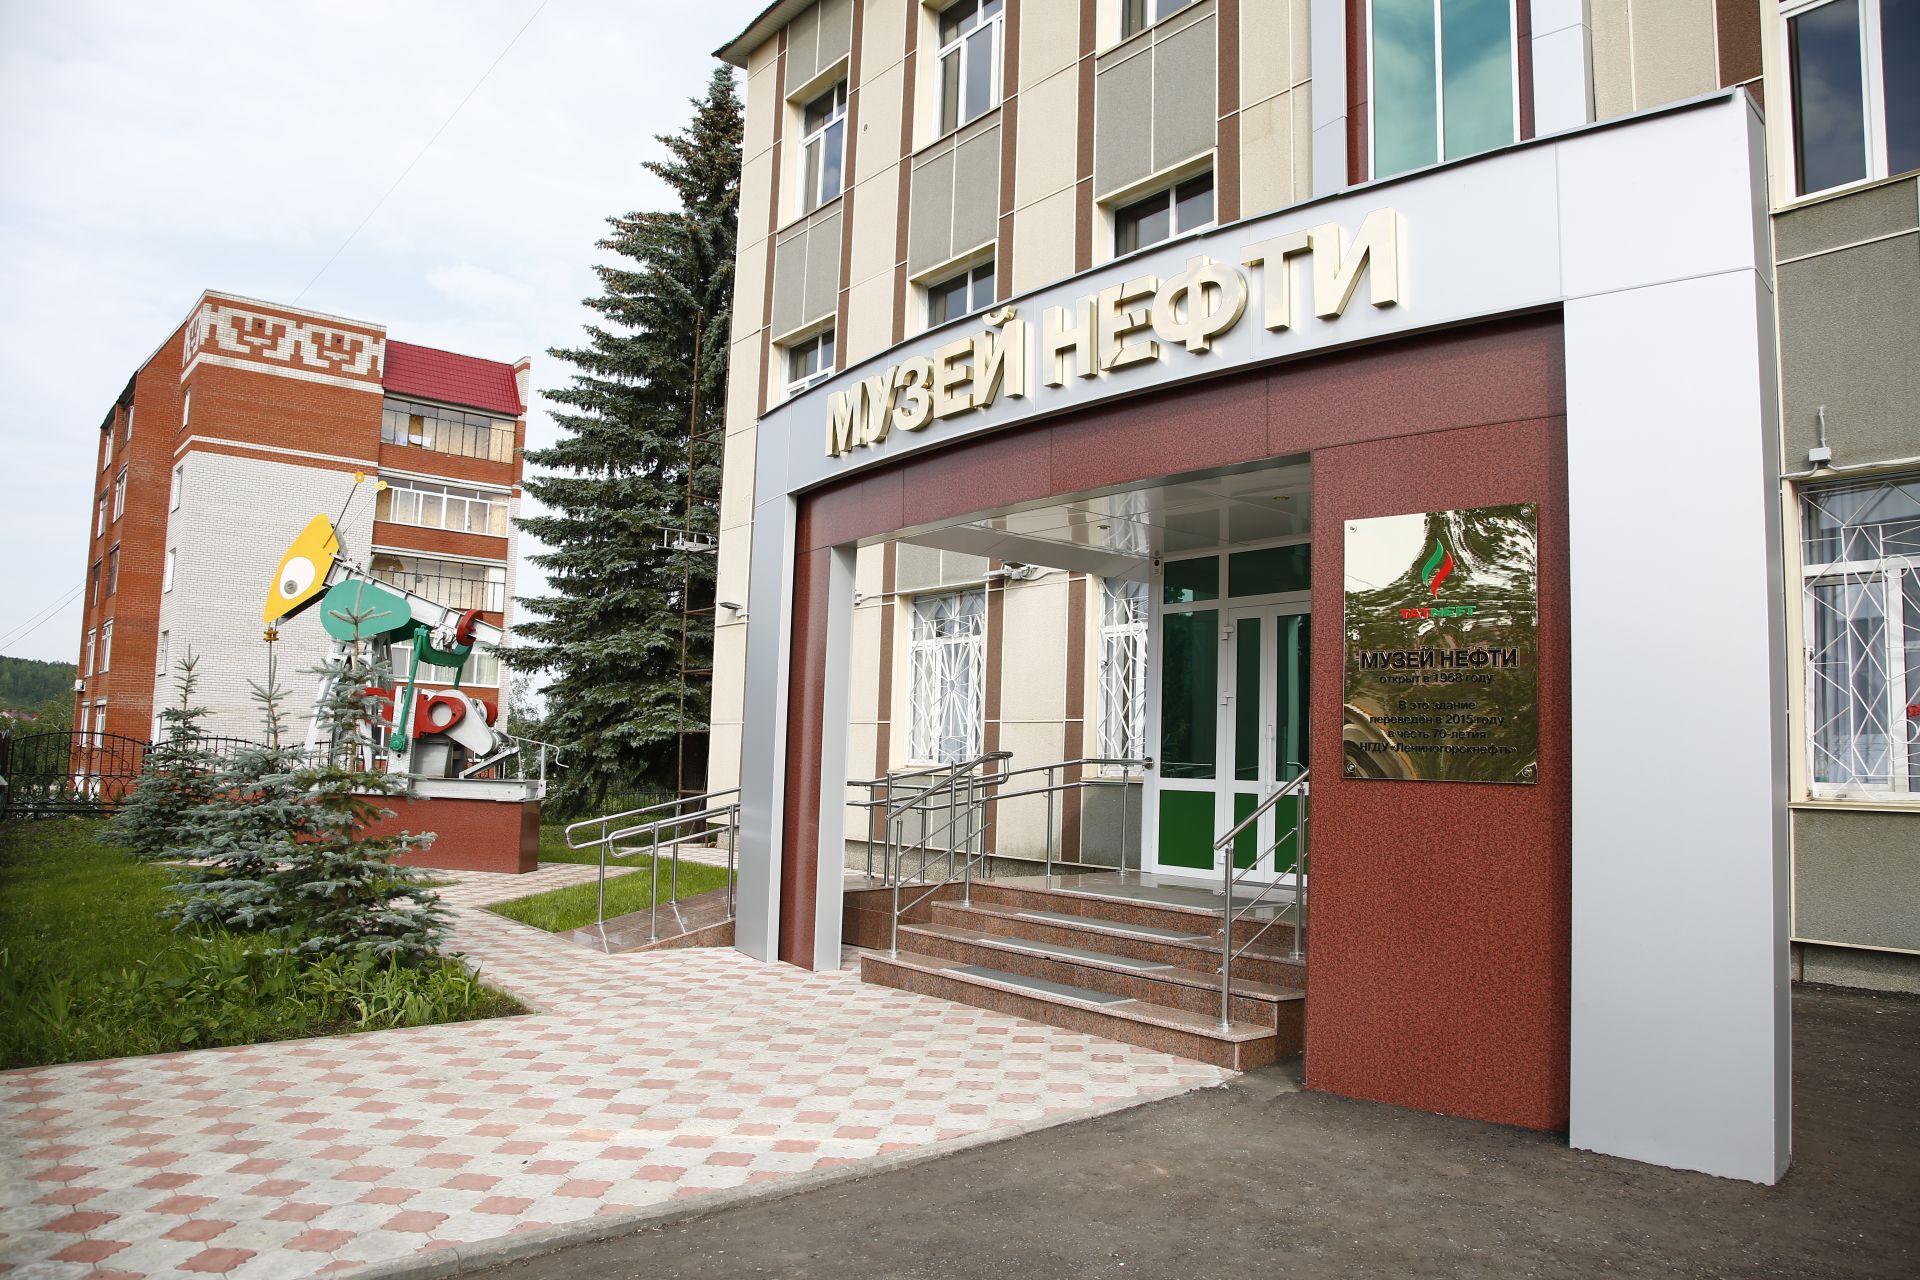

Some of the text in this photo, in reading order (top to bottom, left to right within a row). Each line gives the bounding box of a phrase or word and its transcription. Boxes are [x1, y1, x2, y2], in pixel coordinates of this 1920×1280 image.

[825, 207, 1398, 457] МУЗЕЙ НЕФТИ
[1400, 606, 1477, 619] TATNEFT
[1360, 645, 1519, 670] МУЗЕЙ НЕФТИ
[1380, 673, 1419, 685] открыт
[1434, 673, 1463, 683] 1968
[1399, 700, 1476, 711] В это здание
[1436, 716, 1442, 724] в
[1445, 714, 1473, 724] 2015
[1476, 716, 1504, 726] году
[1388, 729, 1487, 739] в честь 70-летия
[1360, 742, 1388, 753] НГДУ
